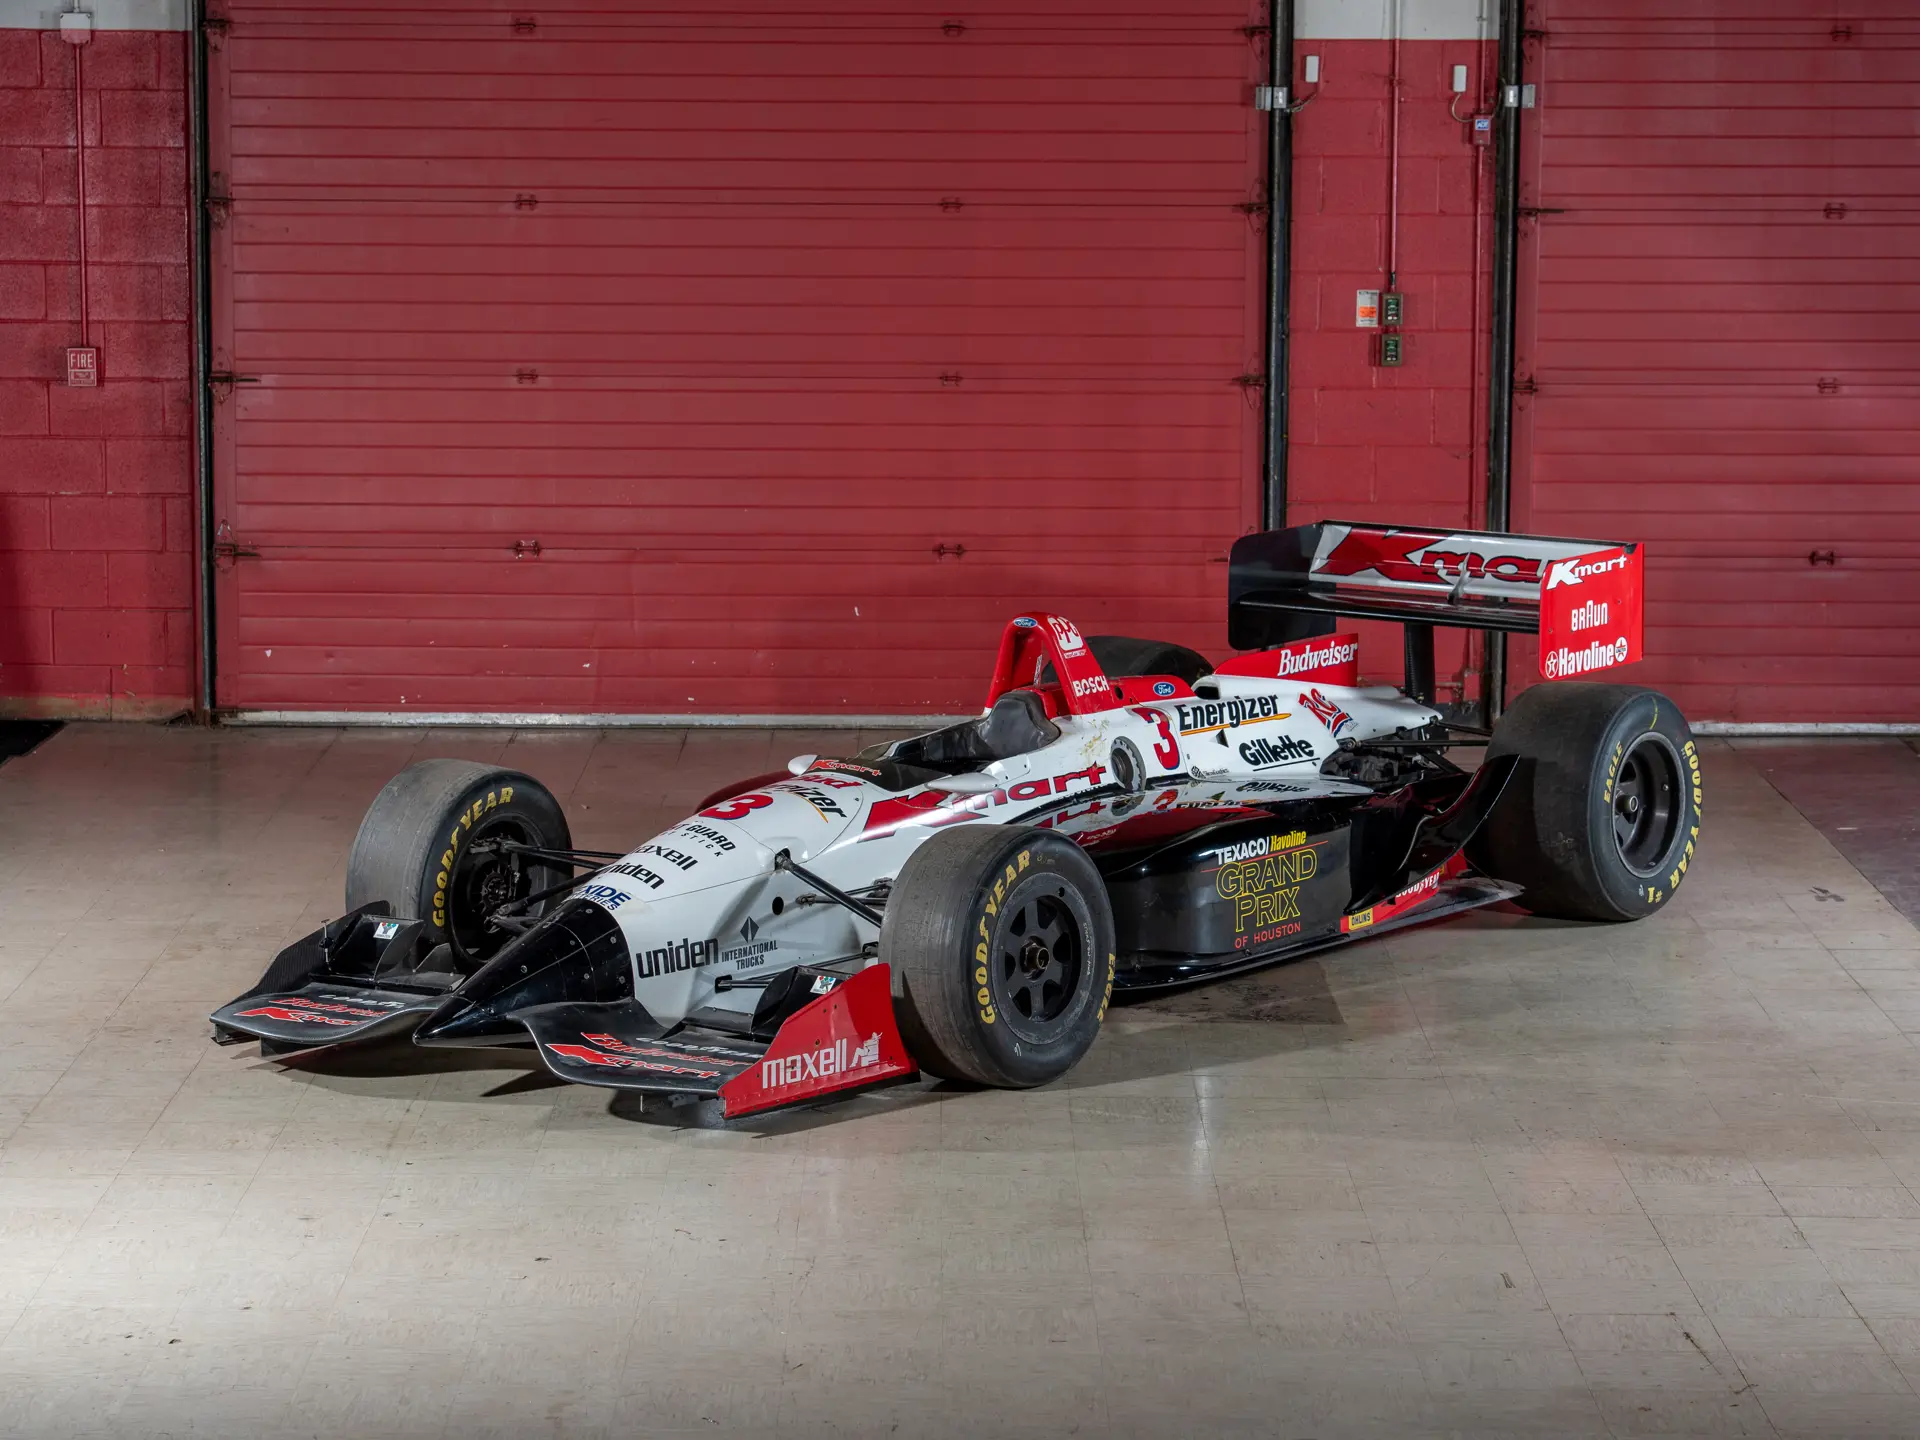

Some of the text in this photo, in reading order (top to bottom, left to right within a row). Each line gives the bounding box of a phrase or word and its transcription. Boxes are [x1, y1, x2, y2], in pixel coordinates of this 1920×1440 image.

[70, 353, 93, 368] FIRE
[1313, 527, 1549, 586] Kma
[1546, 554, 1627, 590] Kmart
[1571, 600, 1608, 631] BRAUN
[1278, 641, 1358, 677] Budweiser
[1558, 640, 1615, 677] Havoline
[1073, 676, 1110, 697] BOSCH
[1177, 694, 1279, 728] Energizer
[1131, 706, 1180, 771] 3
[1239, 735, 1315, 766] Gillette
[808, 759, 882, 777] Kmart
[1603, 741, 1623, 804] EAGLE
[698, 794, 774, 820] 3
[857, 761, 1107, 843] Kmart
[1668, 740, 1703, 889] GOODYEAR
[681, 833, 724, 857] STICK
[685, 824, 736, 851] GUARD
[433, 787, 514, 927] GOODYEAR
[634, 845, 698, 871] axell
[1216, 848, 1317, 899] GRAND
[605, 863, 664, 890] niden
[580, 884, 632, 907] XIDE
[1236, 886, 1301, 932] PRIX
[721, 940, 778, 963] INTERNATIONAL
[975, 850, 1030, 1024] GOODYEAR
[1234, 922, 1301, 949] OF HOUSTON
[636, 938, 719, 979] uniden
[736, 954, 765, 971] TRUCKS
[233, 1006, 367, 1027] Kmar
[544, 1043, 721, 1080] Kmart
[762, 1038, 848, 1090] maxell
